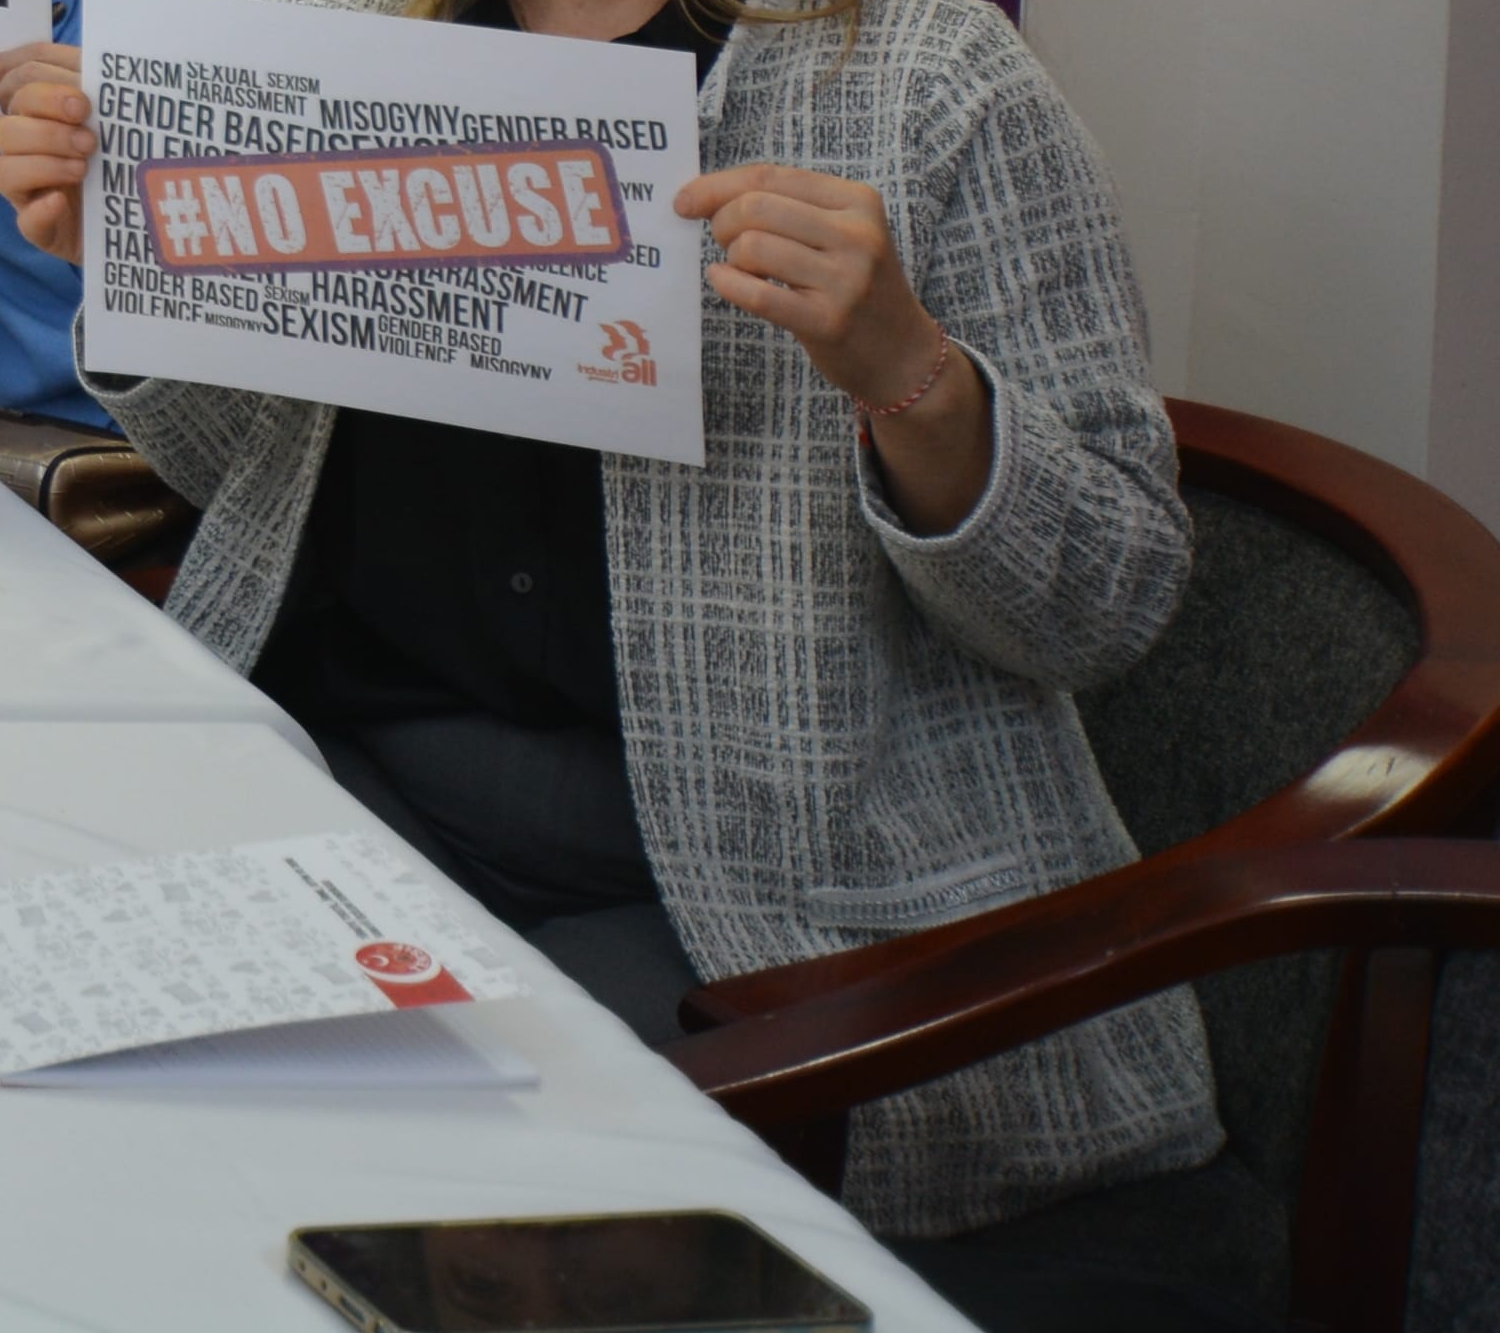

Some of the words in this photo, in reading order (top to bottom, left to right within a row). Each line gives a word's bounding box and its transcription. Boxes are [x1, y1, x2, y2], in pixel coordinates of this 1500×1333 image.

[101, 52, 182, 90] SEXISM
[187, 61, 262, 89] SEXUAL
[267, 72, 320, 95] SEXISM
[186, 79, 308, 116] HARASSMENT
[99, 82, 215, 141] GENDER
[224, 109, 324, 154] BASED
[319, 98, 460, 139] MISOGYNY
[461, 112, 568, 146] GENDER
[576, 117, 669, 152] BASED
[158, 173, 307, 257] #NO
[319, 160, 613, 254] EXCUSE
[104, 261, 185, 299] GENDER
[191, 278, 259, 313] BASED
[104, 288, 203, 323] VIOLENCE
[264, 285, 310, 306] SEXISM
[312, 269, 510, 334] HARASSMENT
[262, 301, 376, 352] SEXISM
[378, 314, 444, 346] GENDER
[447, 328, 502, 357] BASED
[377, 333, 457, 365] VIOLENCE
